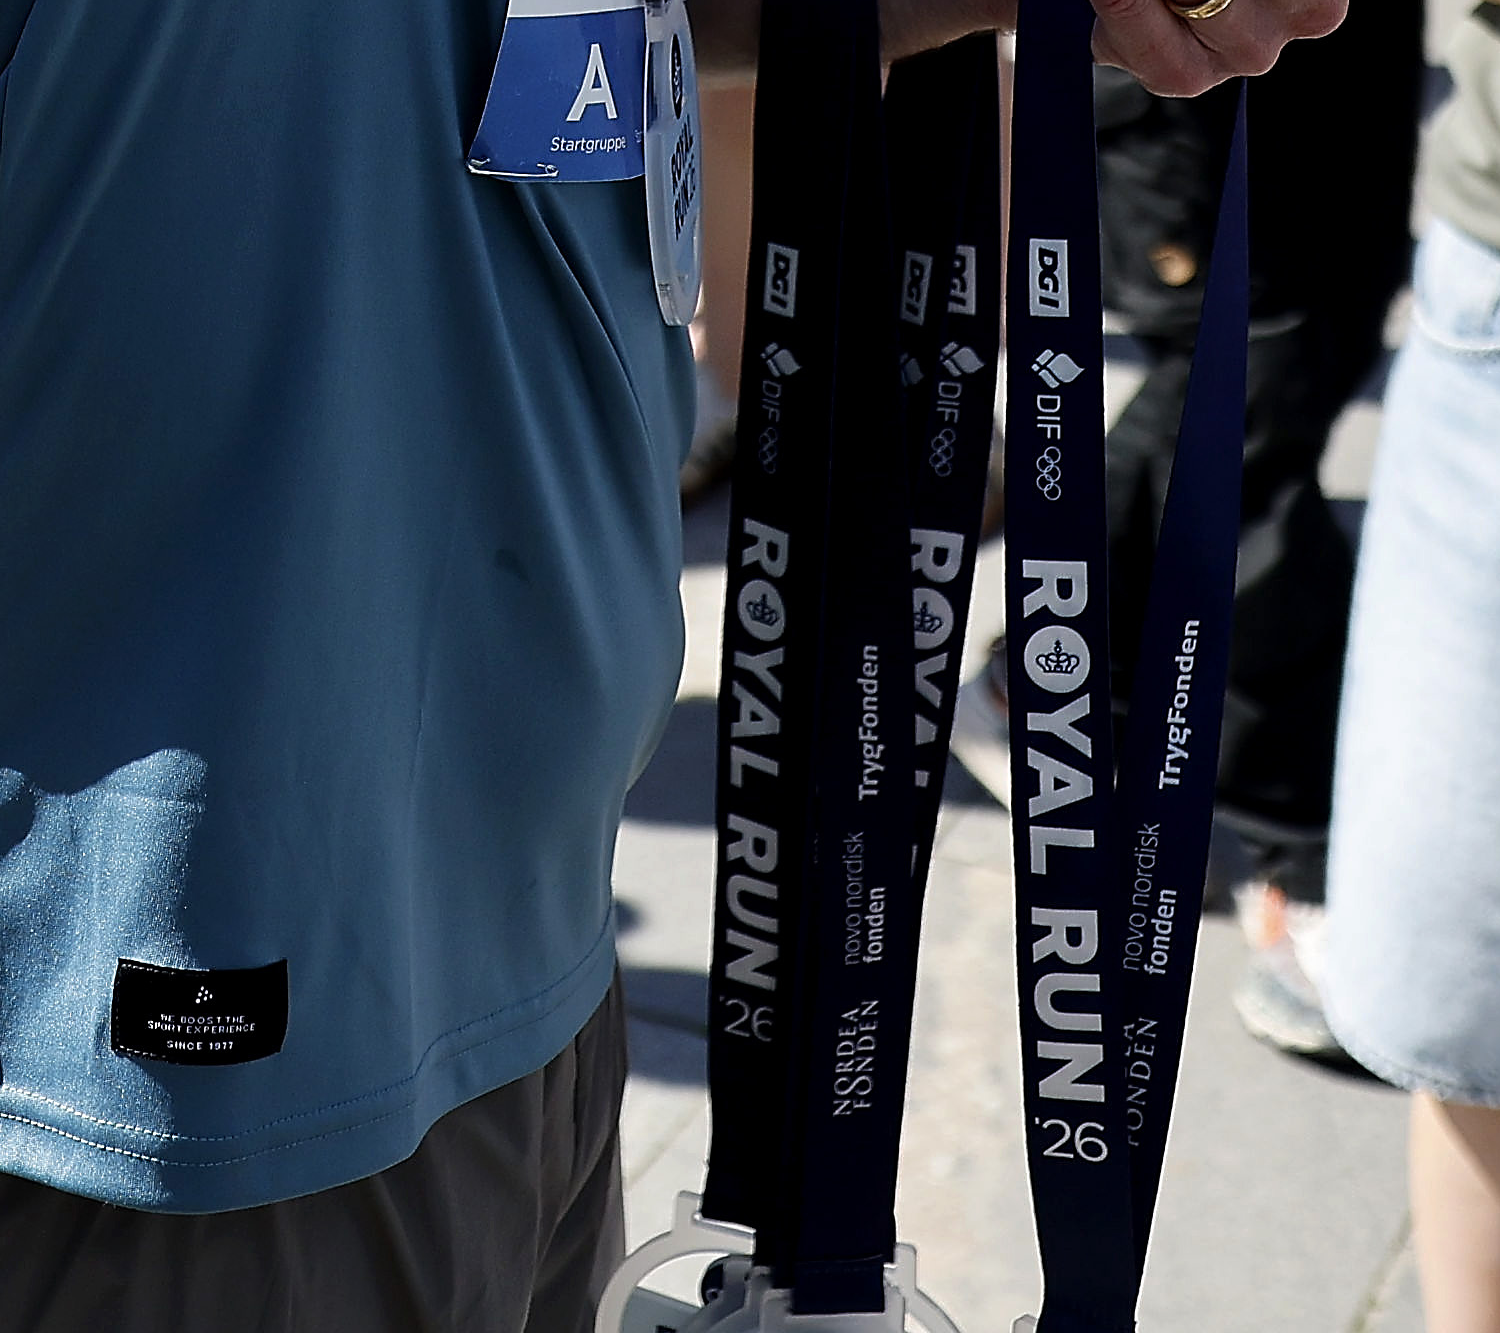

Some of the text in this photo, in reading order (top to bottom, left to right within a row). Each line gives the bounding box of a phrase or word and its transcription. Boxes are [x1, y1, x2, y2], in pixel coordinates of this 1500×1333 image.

[565, 43, 618, 122] A
[550, 134, 627, 156] Startgruppe
[770, 251, 791, 310] DGI
[906, 259, 924, 318] DGI
[1038, 247, 1060, 310] DGI
[762, 380, 782, 423] DIF
[937, 382, 963, 424] DIF
[1037, 394, 1061, 439] DIF
[730, 517, 790, 789] ROYAL
[857, 645, 886, 801] TrygFonden
[1022, 559, 1094, 875] ROYAL
[1158, 619, 1200, 790] TrygFonden
[725, 812, 779, 992] RUN
[842, 831, 865, 966] novo nordisk
[863, 886, 887, 964] fonden
[1123, 822, 1161, 971] novo nordisk
[1143, 888, 1177, 976] fonden
[147, 1020, 256, 1035] SPORT EXPERIENCE
[226, 1015, 246, 1024] THE
[1031, 906, 1105, 1103] RUN
[166, 1040, 234, 1051] SINCE 1977
[833, 1007, 860, 1118] NORDEA
[853, 1000, 880, 1110] FONDEN
